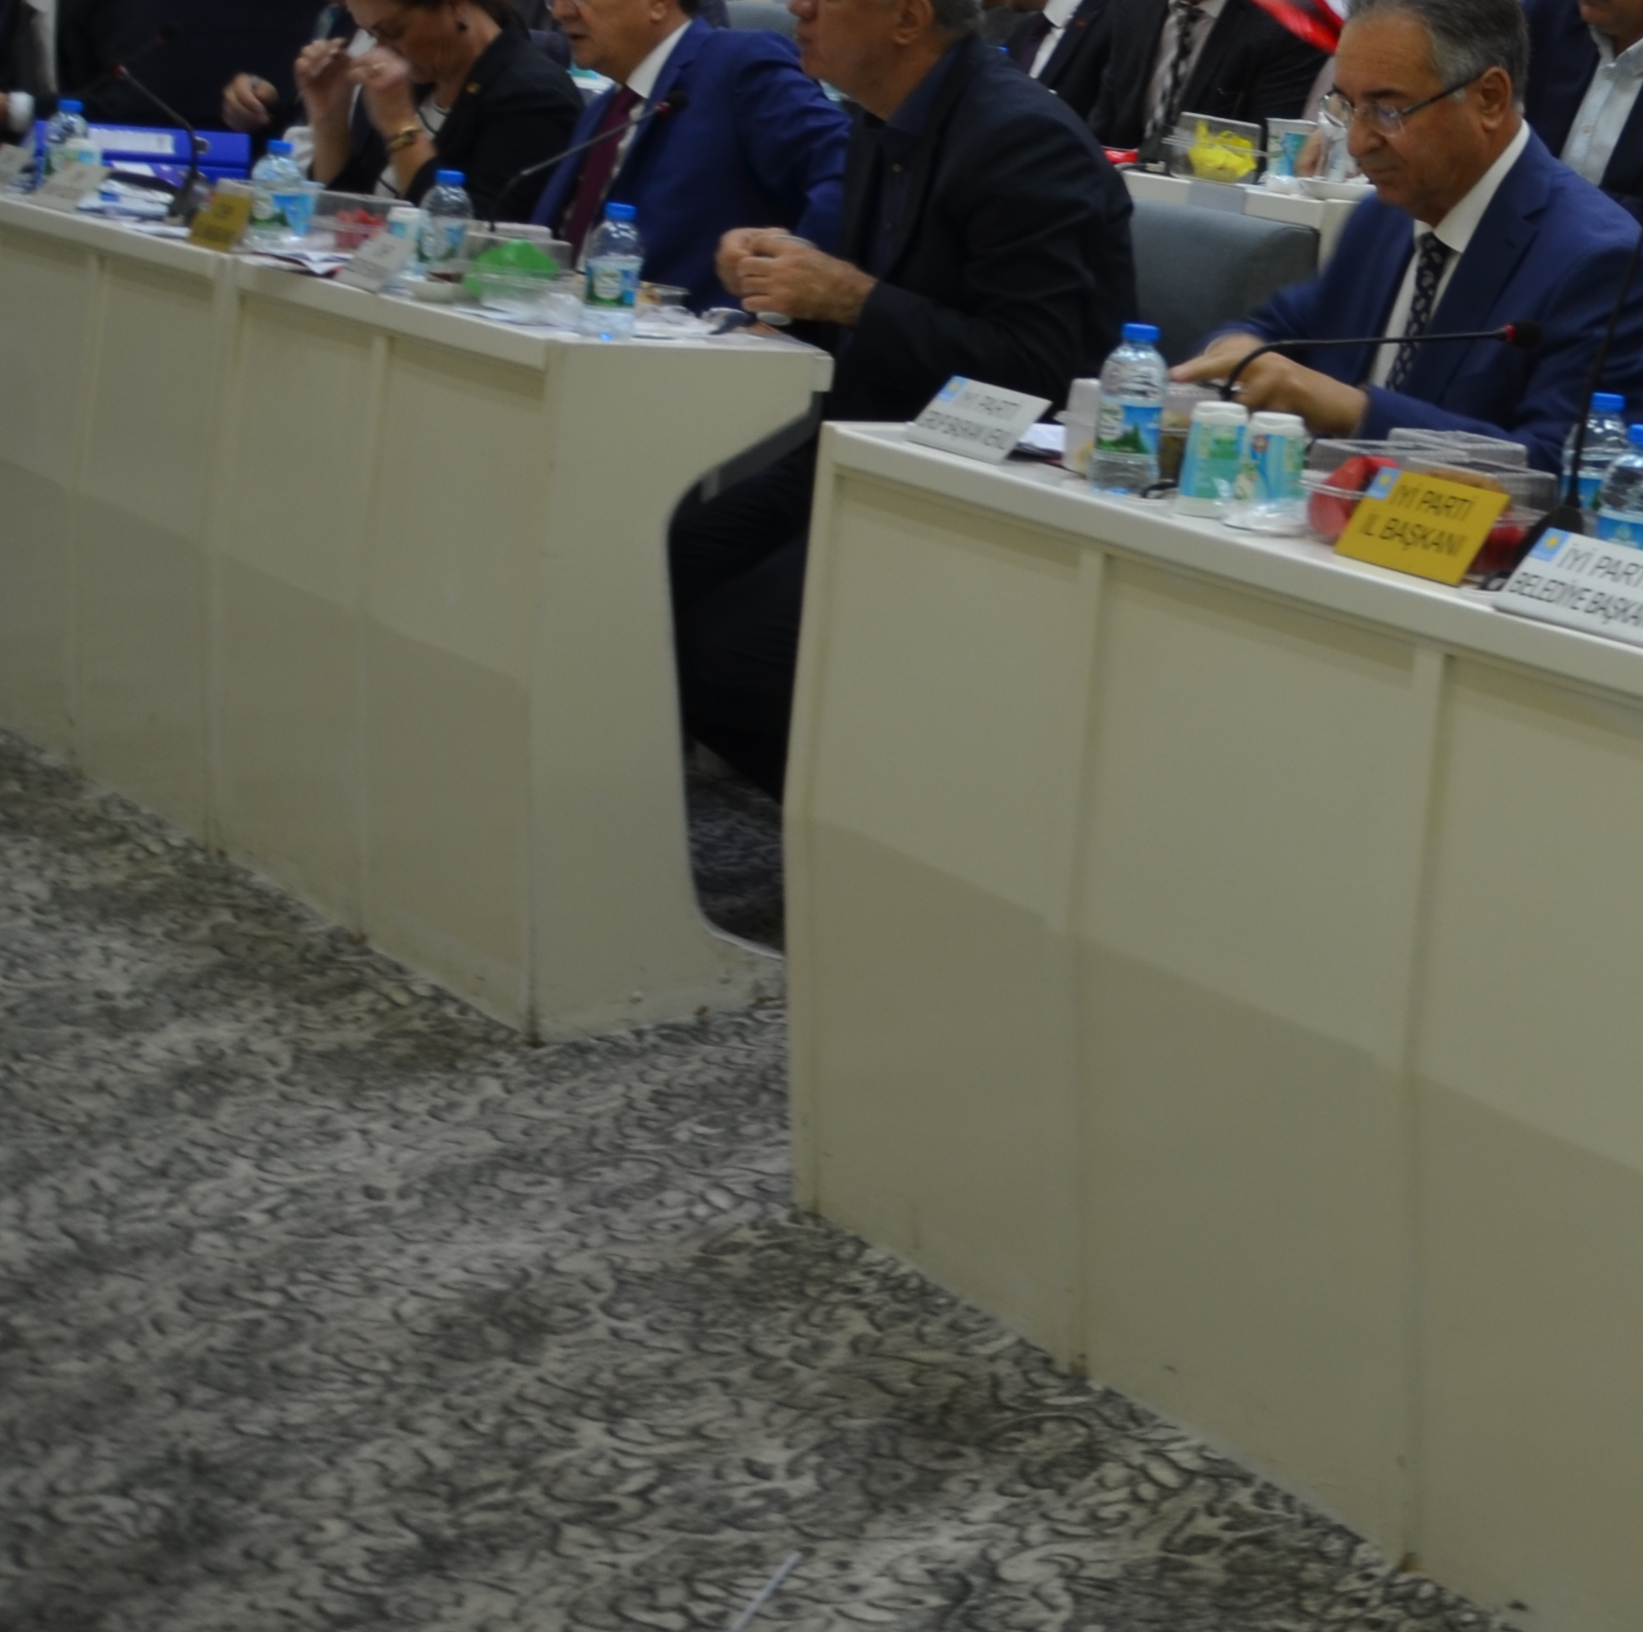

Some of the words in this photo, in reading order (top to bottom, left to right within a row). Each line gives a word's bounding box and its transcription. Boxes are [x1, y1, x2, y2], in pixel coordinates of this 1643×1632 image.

[1415, 488, 1479, 523] PARTİ
[1556, 541, 1599, 577] İYİ
[1507, 571, 1592, 615] BELEDİYE
